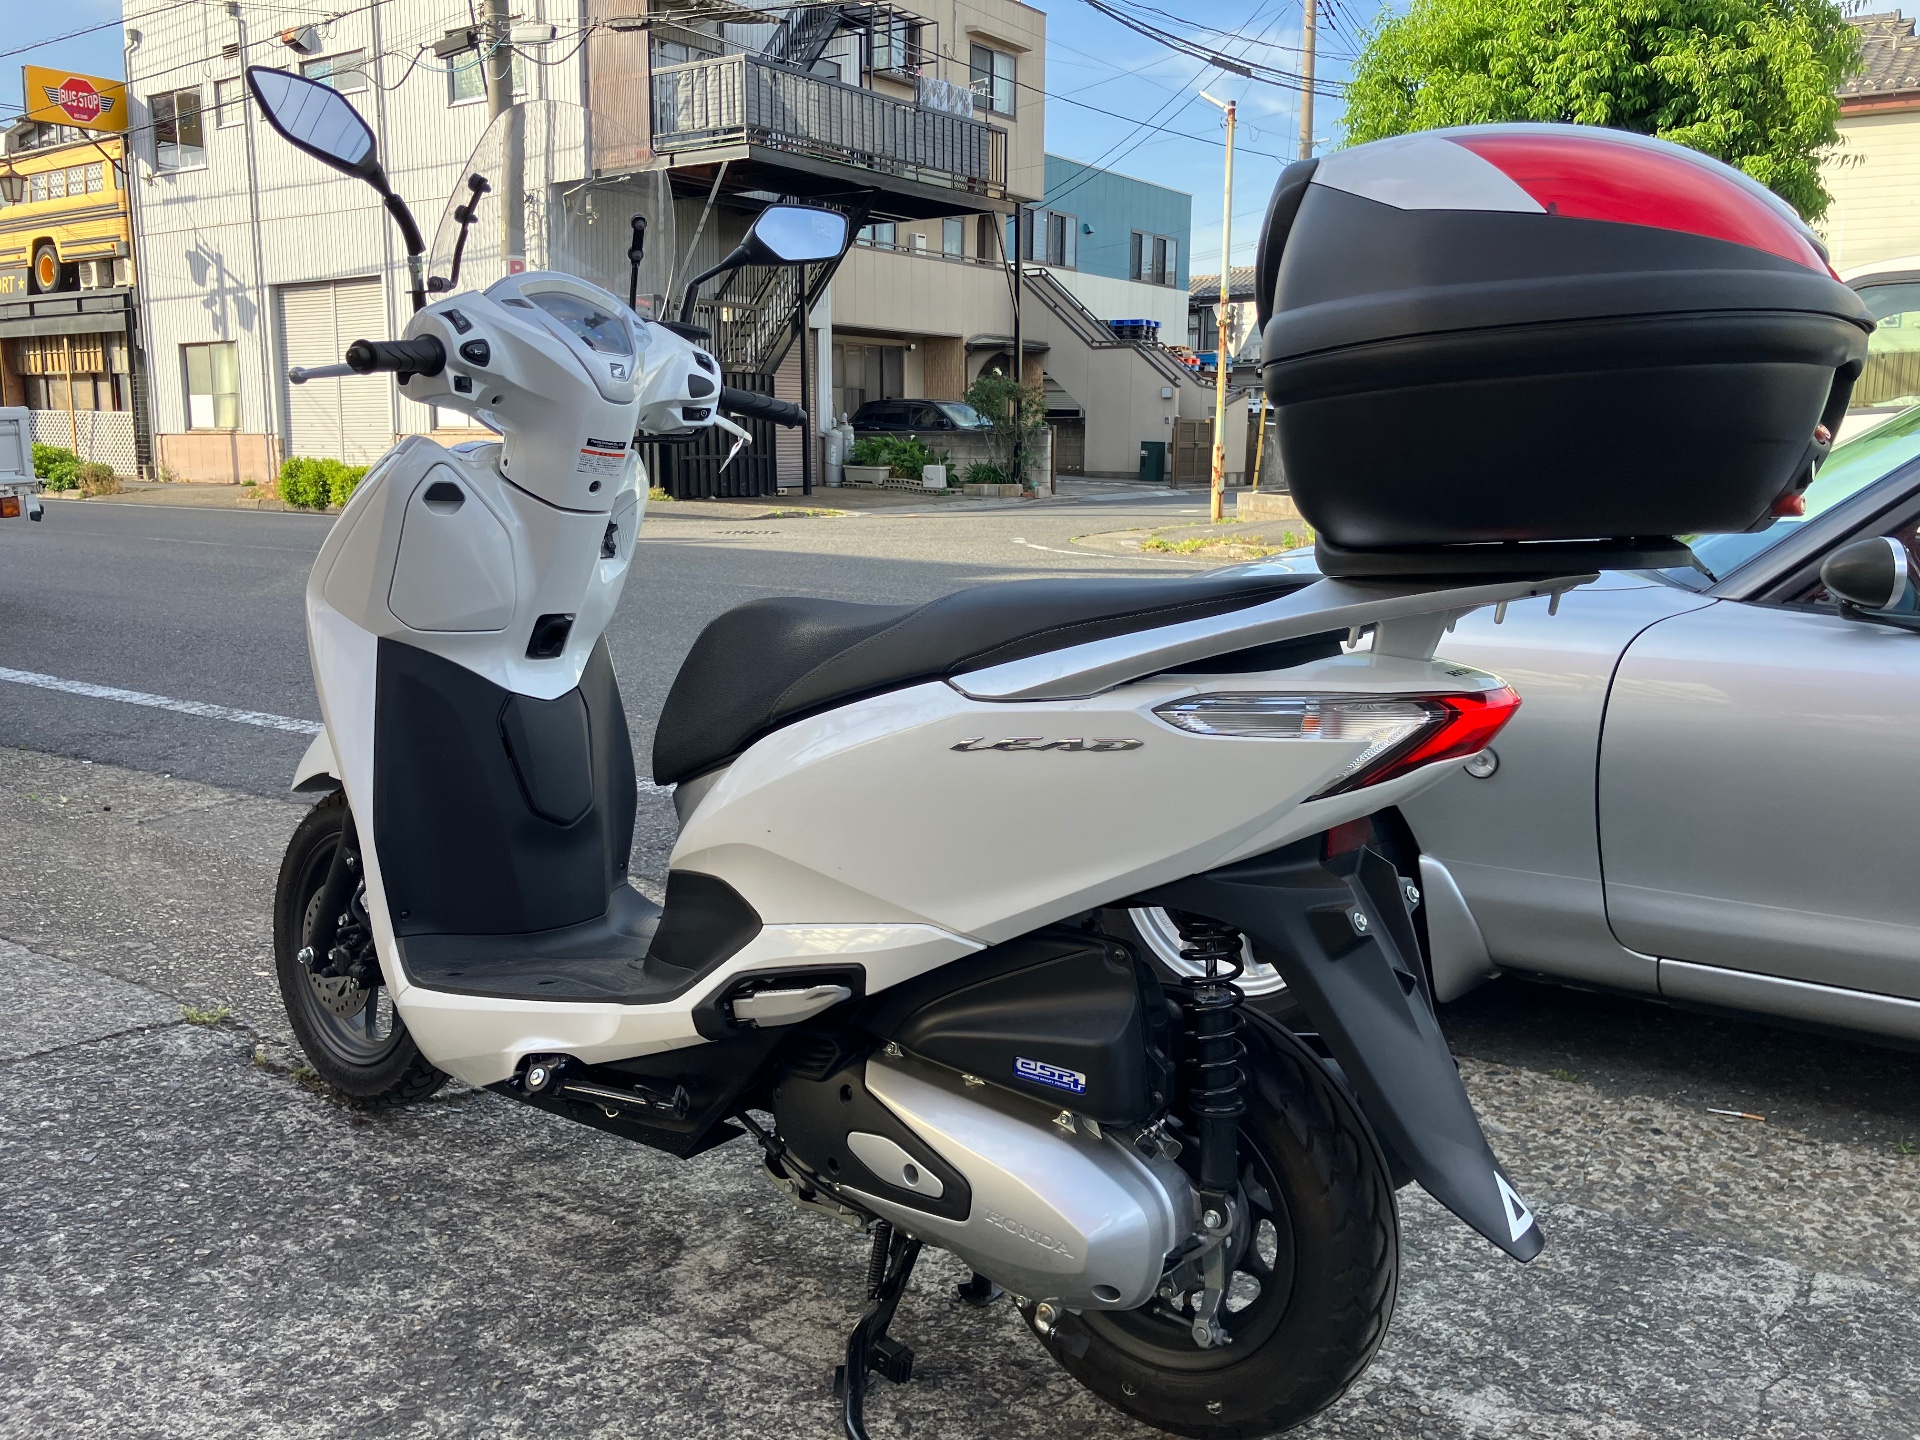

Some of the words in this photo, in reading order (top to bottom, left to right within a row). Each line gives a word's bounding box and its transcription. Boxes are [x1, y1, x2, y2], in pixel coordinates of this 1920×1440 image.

[60, 89, 77, 107] BUS
[78, 91, 99, 109] STOP
[0, 275, 16, 294] RT
[949, 736, 1145, 752] LEAD
[984, 1208, 1076, 1260] HONDA
